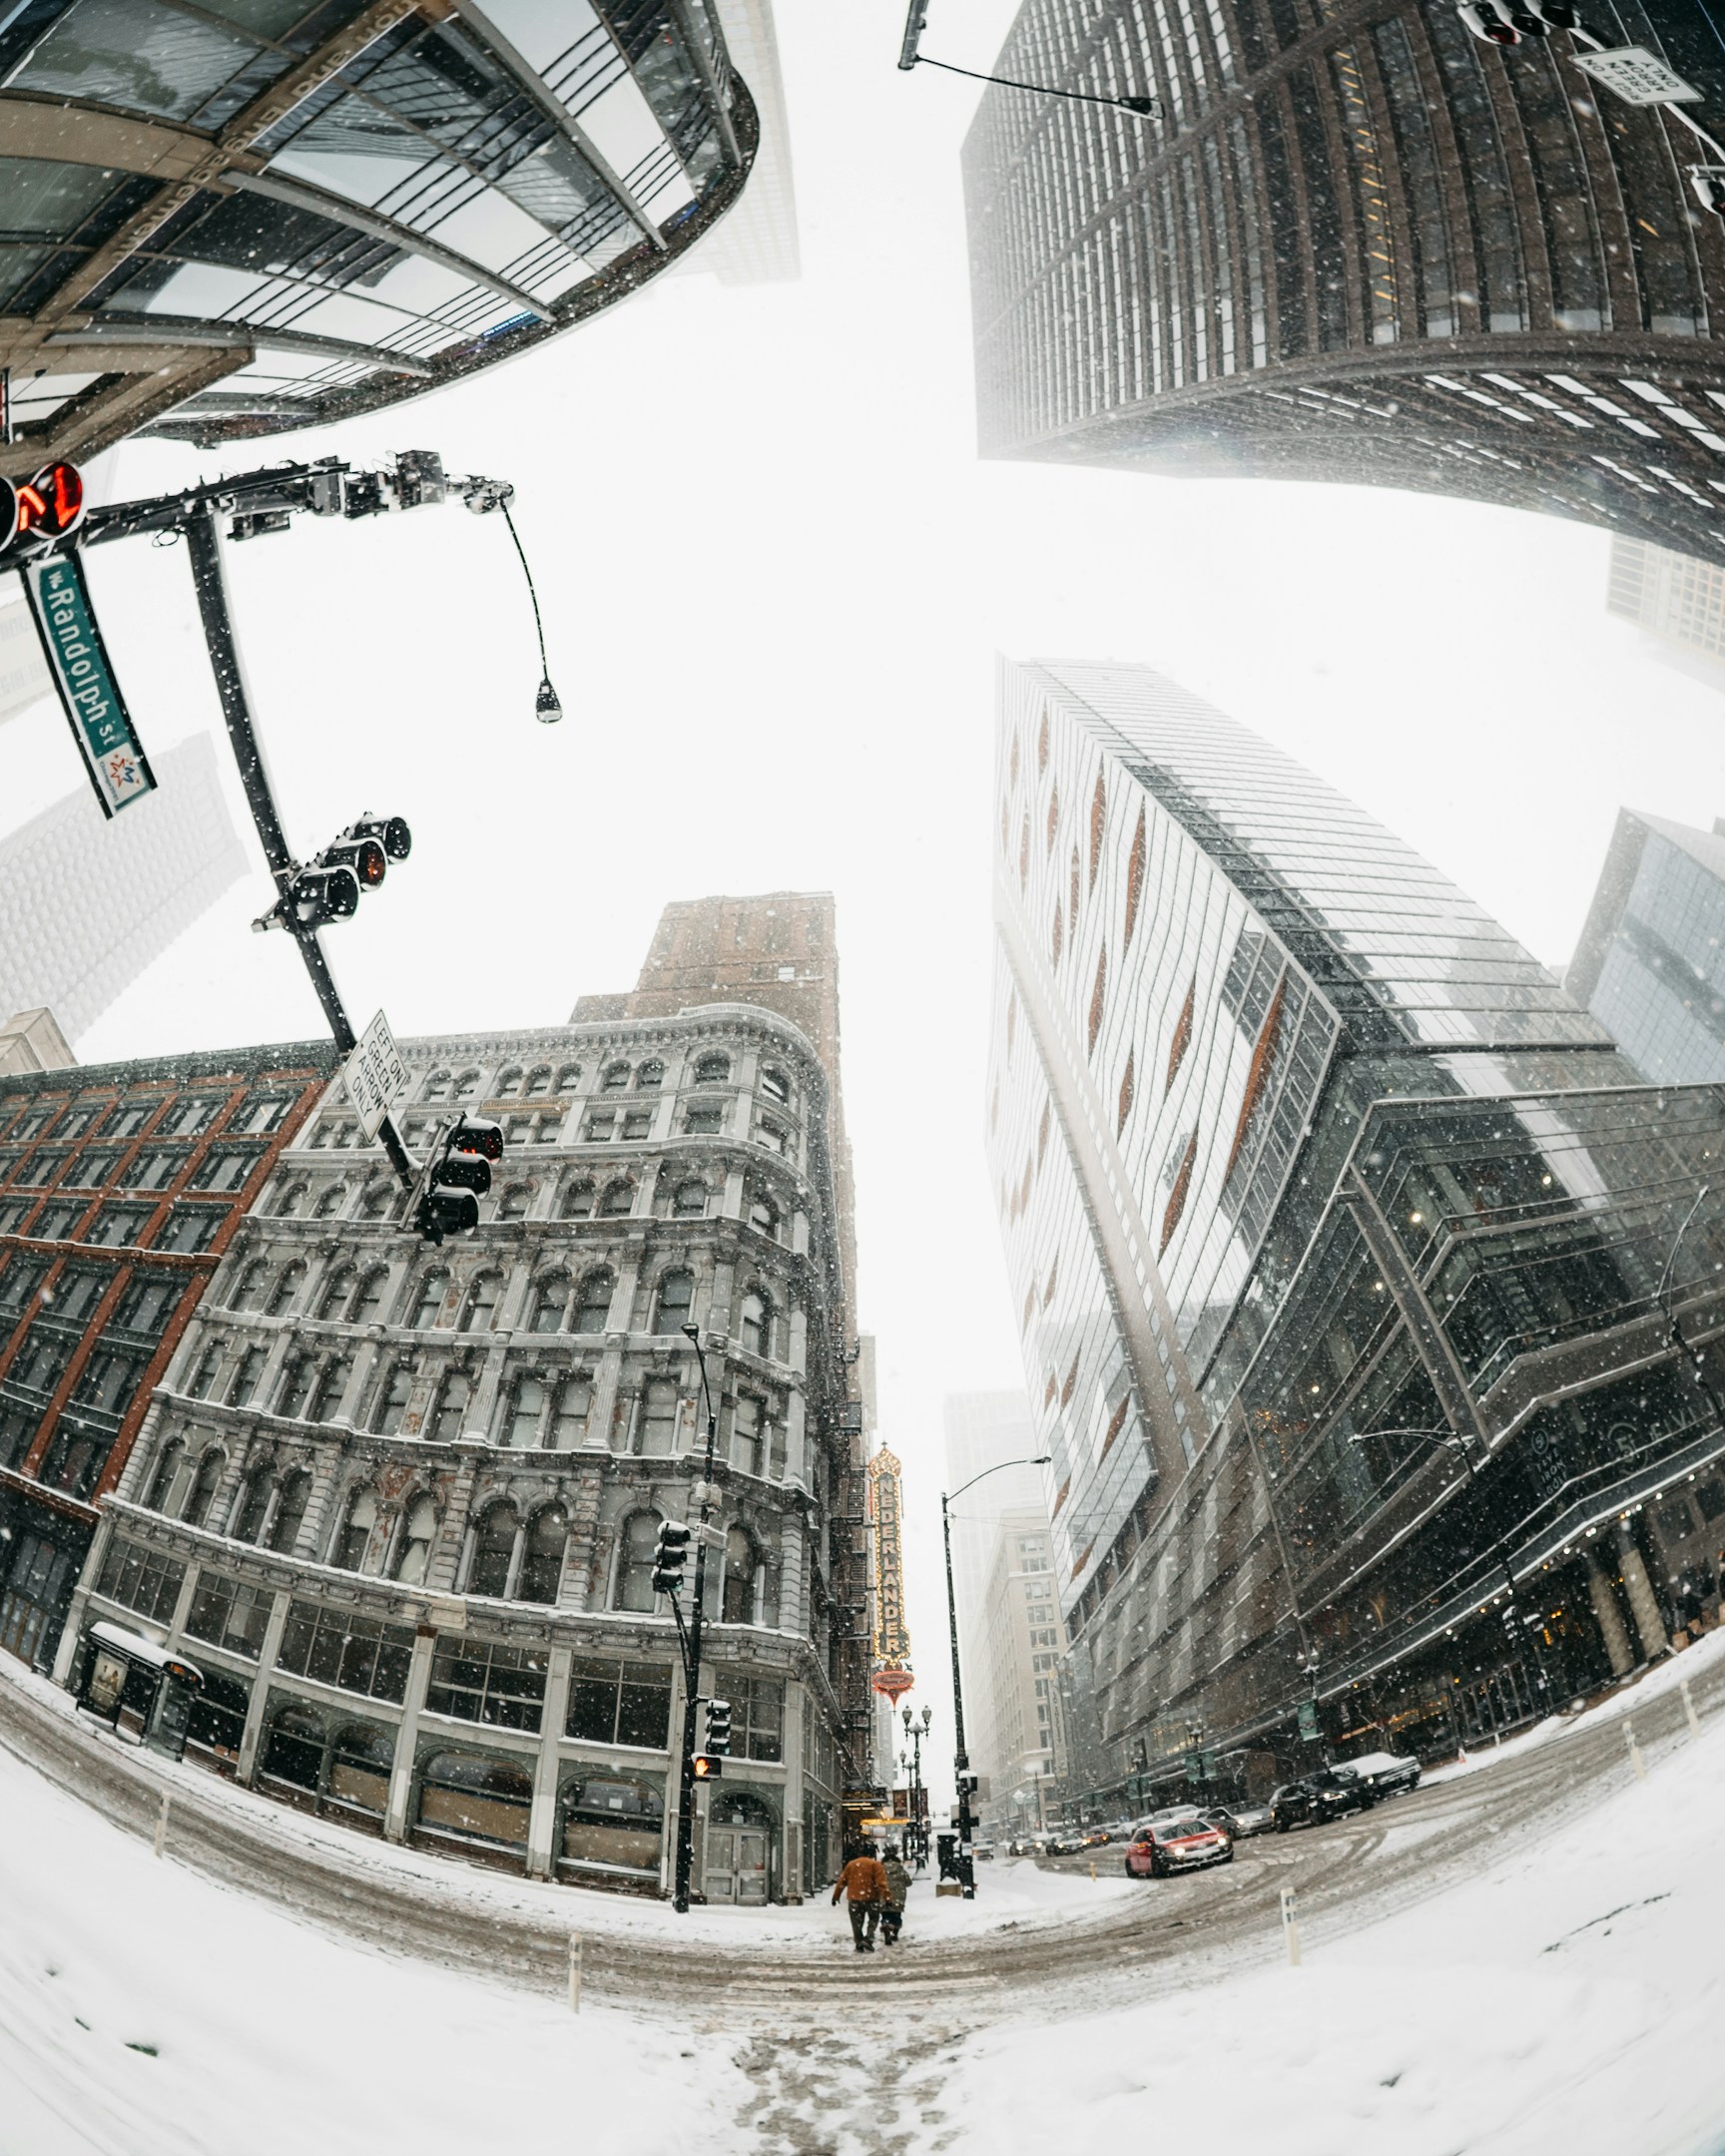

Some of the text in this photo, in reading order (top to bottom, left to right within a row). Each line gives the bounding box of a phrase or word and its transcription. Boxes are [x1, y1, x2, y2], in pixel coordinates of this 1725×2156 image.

[291, 50, 351, 98] and
[1583, 59, 1606, 73] ON
[1605, 62, 1652, 94] GREEN
[1619, 59, 1669, 93] ARROW
[1640, 62, 1679, 89] ONLY
[111, 105, 286, 264] Engagement
[47, 588, 107, 723] Randolph
[367, 1040, 392, 1094] GREEN
[372, 1018, 403, 1085] LEFT ON
[352, 1076, 372, 1118] ONLY
[357, 1055, 384, 1111] ARROW
[1540, 1458, 1566, 1484] IRON
[879, 1478, 900, 1653] NEDERLANDER
